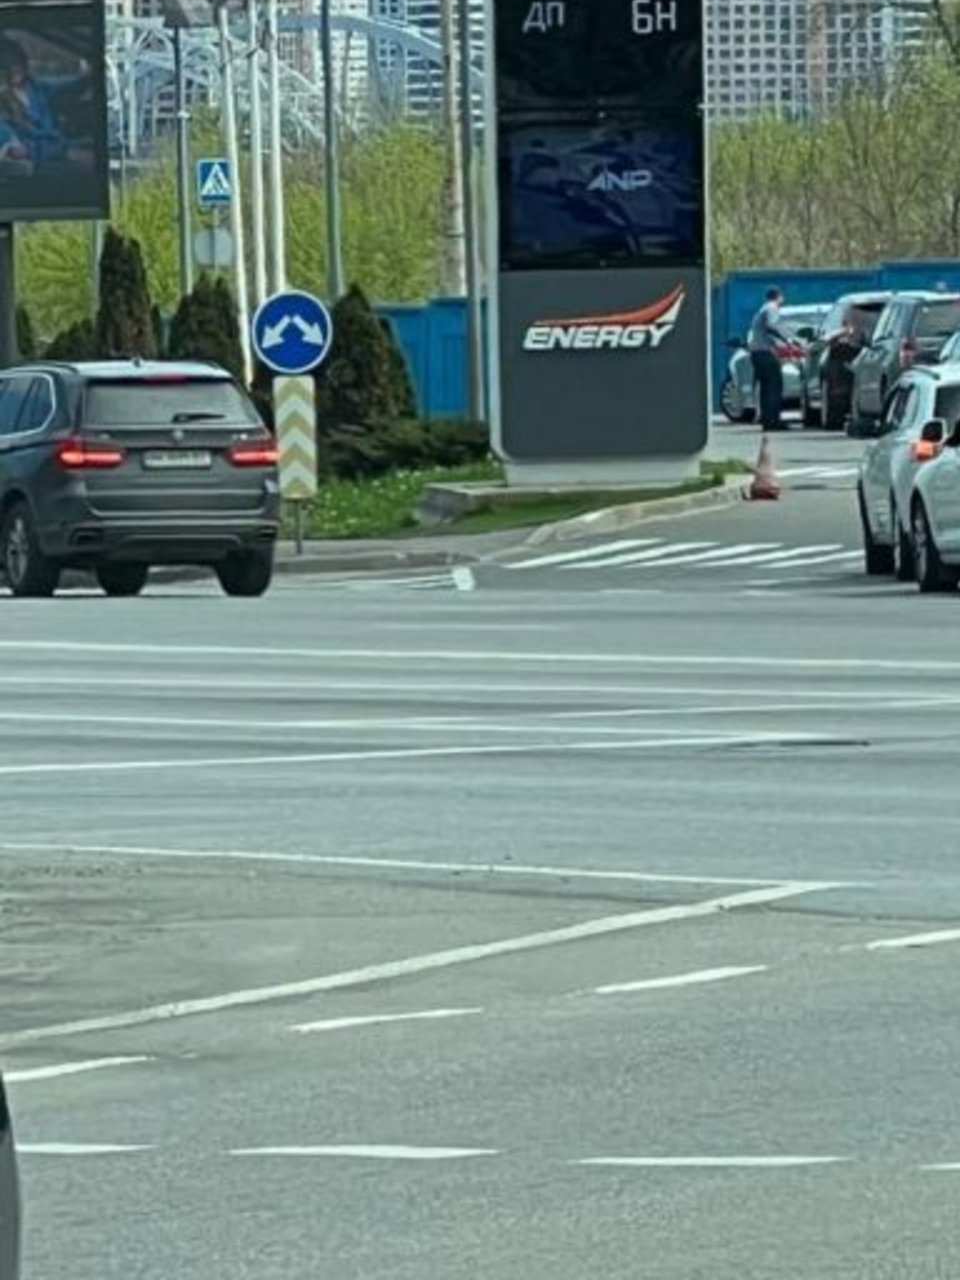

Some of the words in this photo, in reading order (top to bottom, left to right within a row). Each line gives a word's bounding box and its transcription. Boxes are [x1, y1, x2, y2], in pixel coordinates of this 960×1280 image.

[522, 1, 565, 33] ДП
[586, 170, 653, 191] ANP
[523, 323, 676, 350] ENERGY
